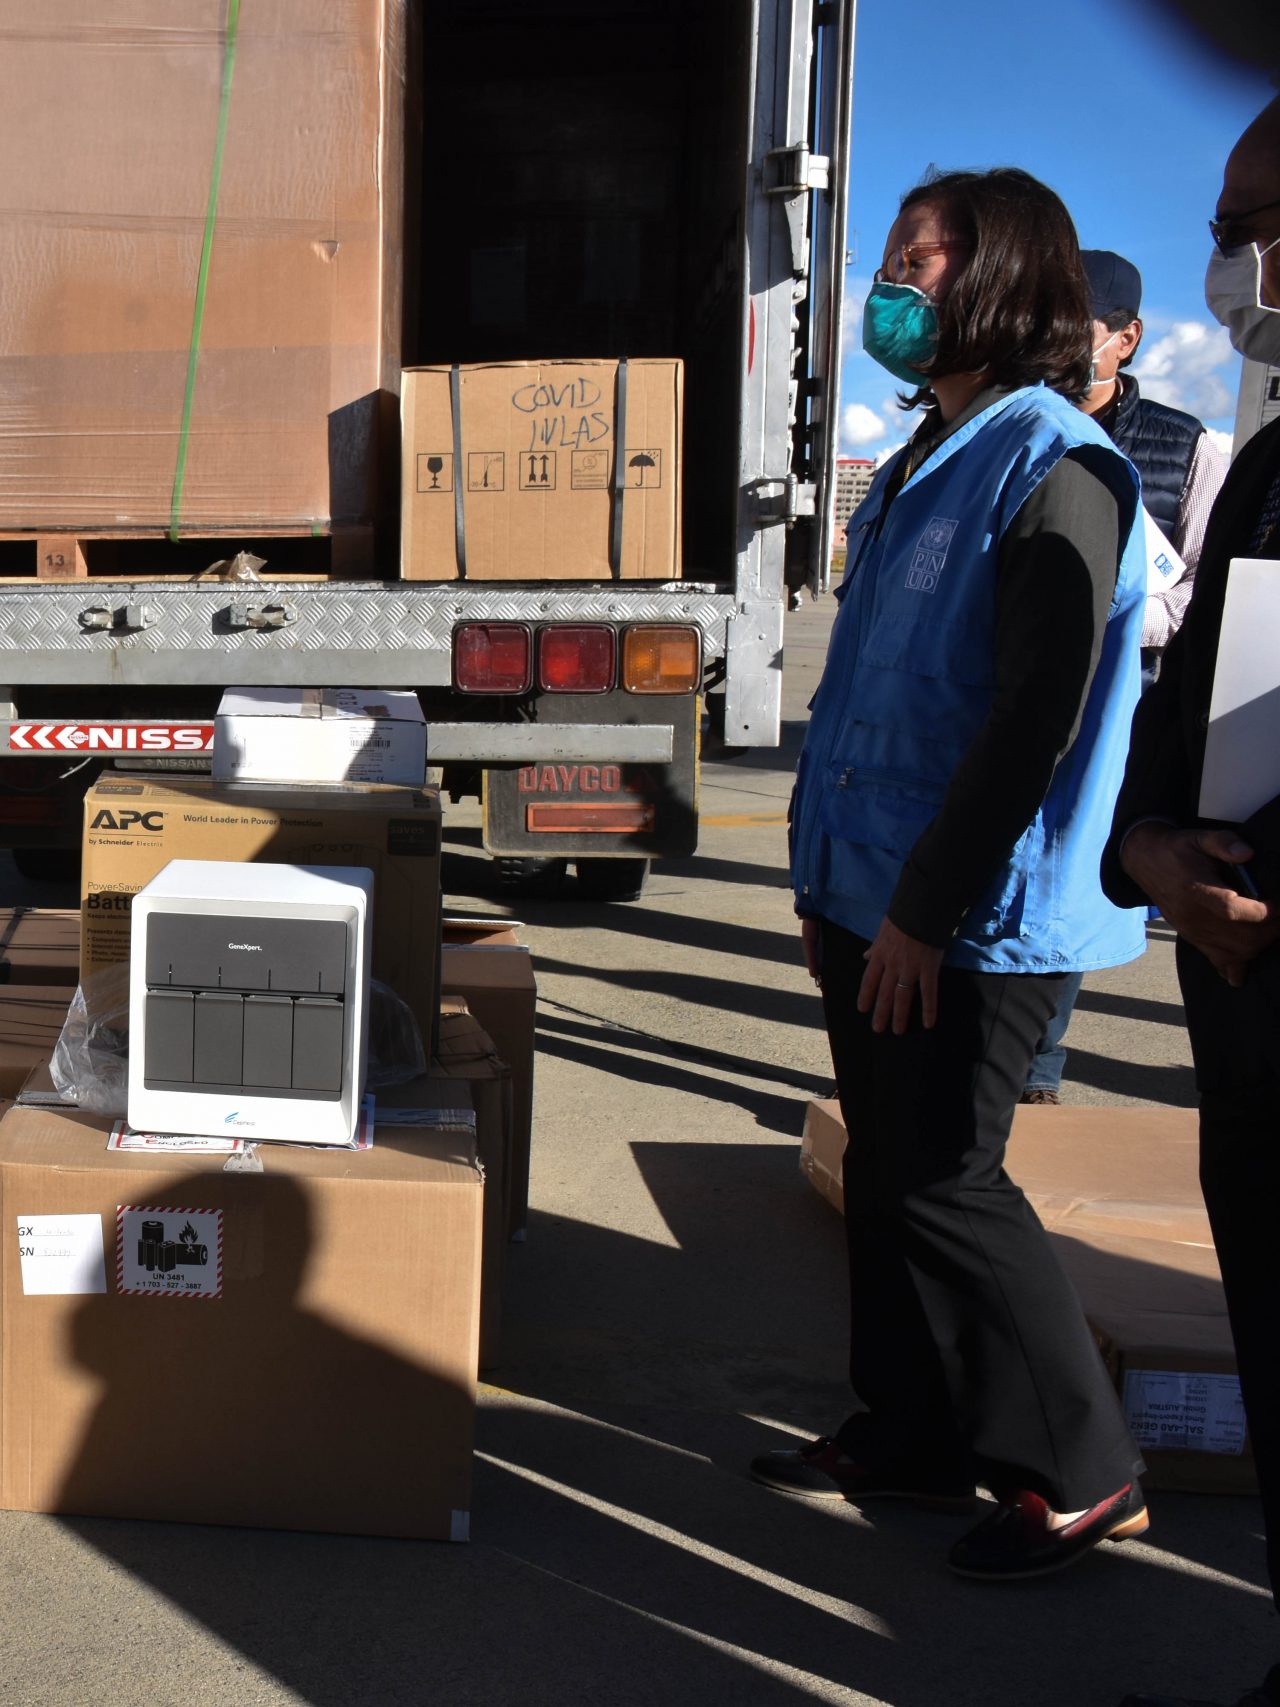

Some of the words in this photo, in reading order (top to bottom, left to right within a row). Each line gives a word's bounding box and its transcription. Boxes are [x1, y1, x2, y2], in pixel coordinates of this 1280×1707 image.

[511, 377, 602, 413] COVID
[46, 554, 65, 567] 13
[155, 758, 207, 769] NISSAN
[517, 765, 621, 793] DAYCO
[90, 809, 164, 832] APC
[183, 814, 208, 823] World
[210, 815, 239, 824] Leader
[241, 816, 249, 824] in
[250, 817, 278, 825] Power
[279, 818, 324, 828] Protection
[88, 838, 97, 846] by
[98, 838, 134, 846] Schneider
[87, 881, 143, 892] Power-Savin
[87, 893, 131, 911] Batt
[17, 1226, 34, 1236] GX
[19, 1246, 35, 1257] SN
[152, 1272, 165, 1280] UN
[166, 1273, 185, 1281] 3481
